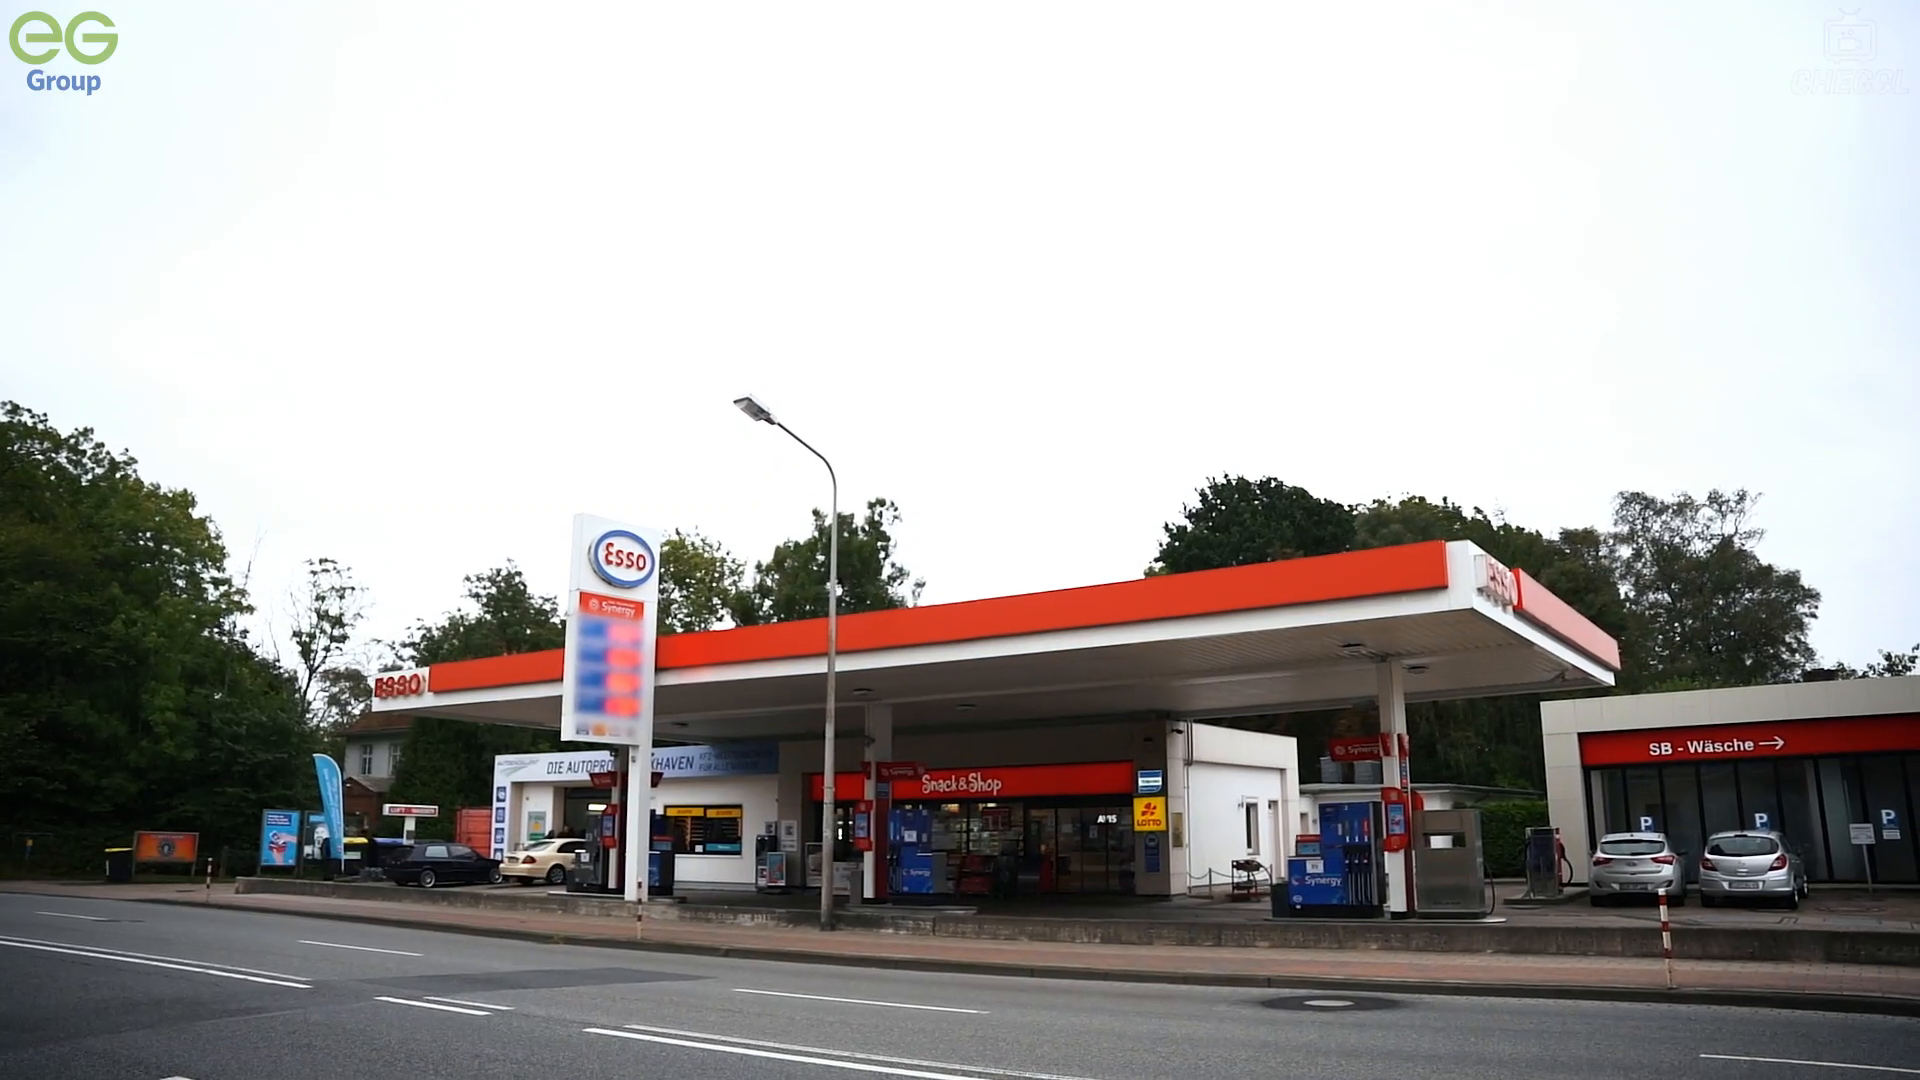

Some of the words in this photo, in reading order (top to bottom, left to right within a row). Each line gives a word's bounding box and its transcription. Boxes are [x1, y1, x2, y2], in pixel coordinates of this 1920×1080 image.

[602, 601, 636, 618] Synergy
[1347, 746, 1380, 756] Synerg
[1649, 742, 1673, 756] SB
[1687, 738, 1755, 754] Wäsche
[547, 761, 564, 775] DIE
[566, 759, 616, 774] AUTOPRO
[1137, 819, 1162, 827] LOTTO
[1640, 816, 1652, 831] P
[1754, 813, 1768, 827] P
[1881, 809, 1896, 825] P
[1305, 875, 1342, 887] Synergy
